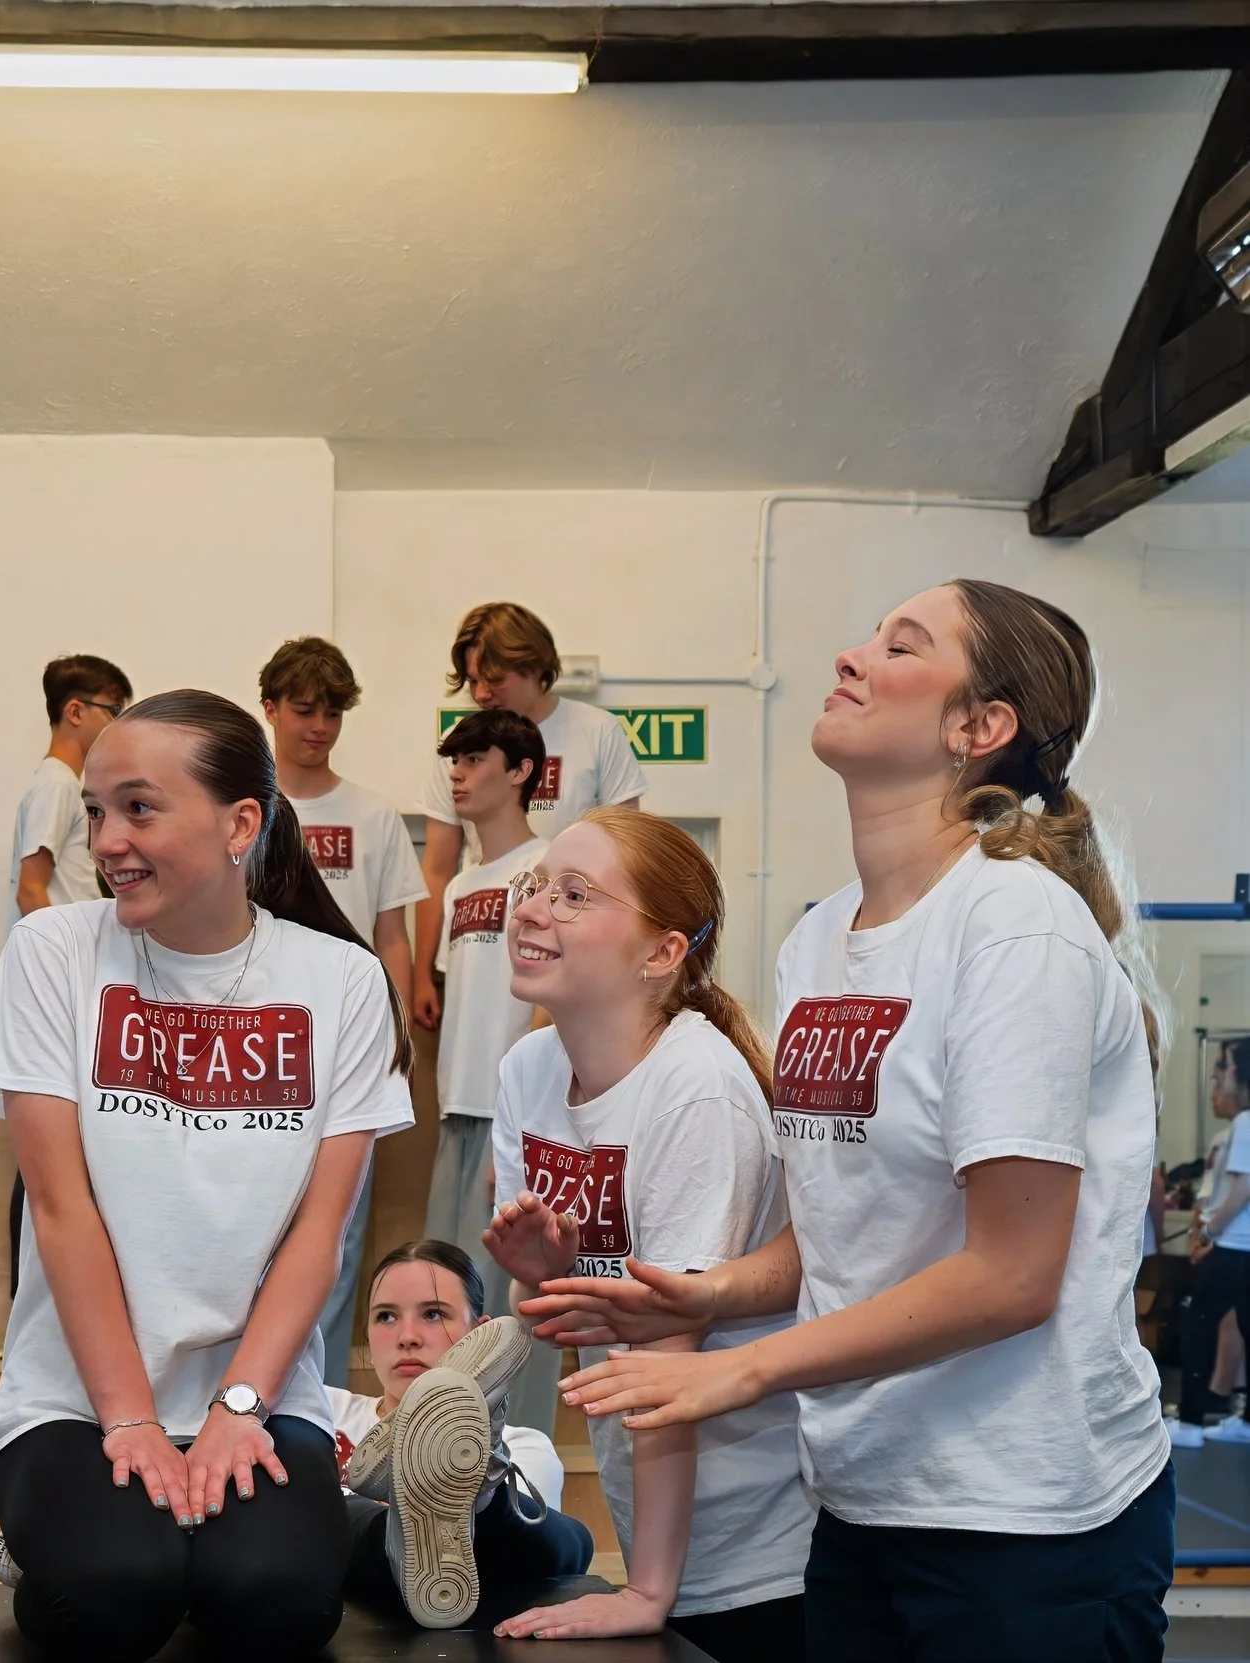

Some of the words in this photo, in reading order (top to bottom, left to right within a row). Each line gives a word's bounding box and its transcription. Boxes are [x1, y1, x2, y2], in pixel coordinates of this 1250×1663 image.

[616, 714, 695, 755] XIT
[308, 835, 348, 858] ASE
[167, 1013, 185, 1028] GO
[192, 1013, 262, 1031] TOGETHER
[120, 1012, 298, 1083] GREASE
[778, 1026, 892, 1082] GREASE
[120, 1068, 134, 1082] 19
[146, 1072, 171, 1093] THE
[181, 1088, 263, 1102] MUSICAL
[282, 1088, 298, 1101] 59
[851, 1090, 863, 1106] 59
[96, 1093, 228, 1131] DOSYTCo
[242, 1111, 304, 1131] 2025
[774, 1115, 825, 1141] OSYTCo
[557, 1154, 573, 1170] GO
[601, 1234, 614, 1248] 59
